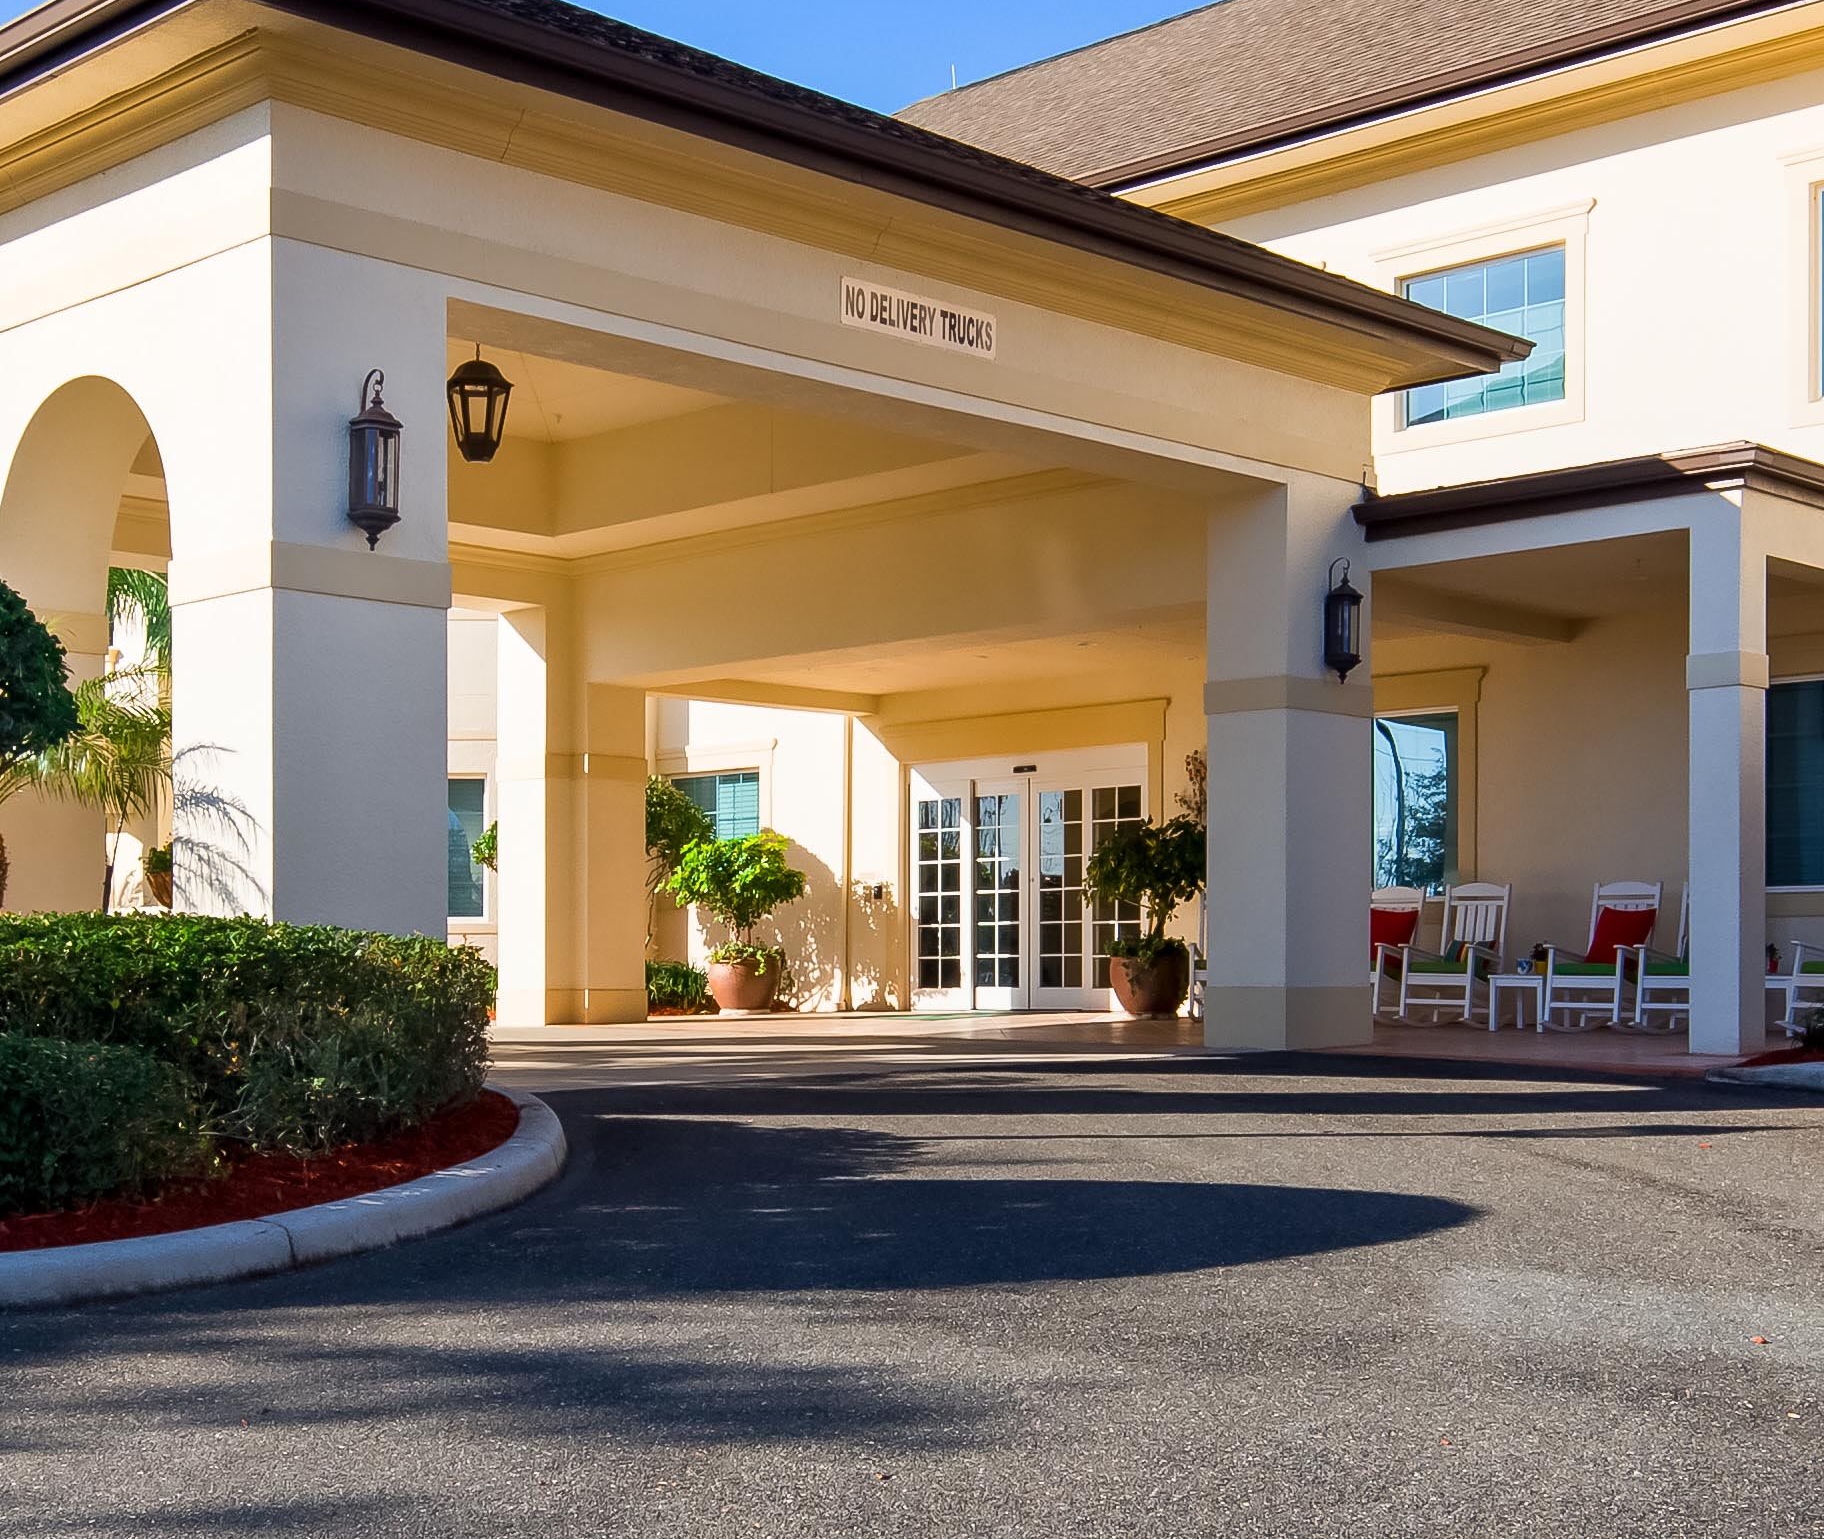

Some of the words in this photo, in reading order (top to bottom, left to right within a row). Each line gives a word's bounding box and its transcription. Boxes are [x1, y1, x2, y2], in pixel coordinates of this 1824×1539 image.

[845, 284, 866, 320] NO
[869, 291, 937, 337] DELIVERY
[940, 309, 993, 352] TRUCKS
